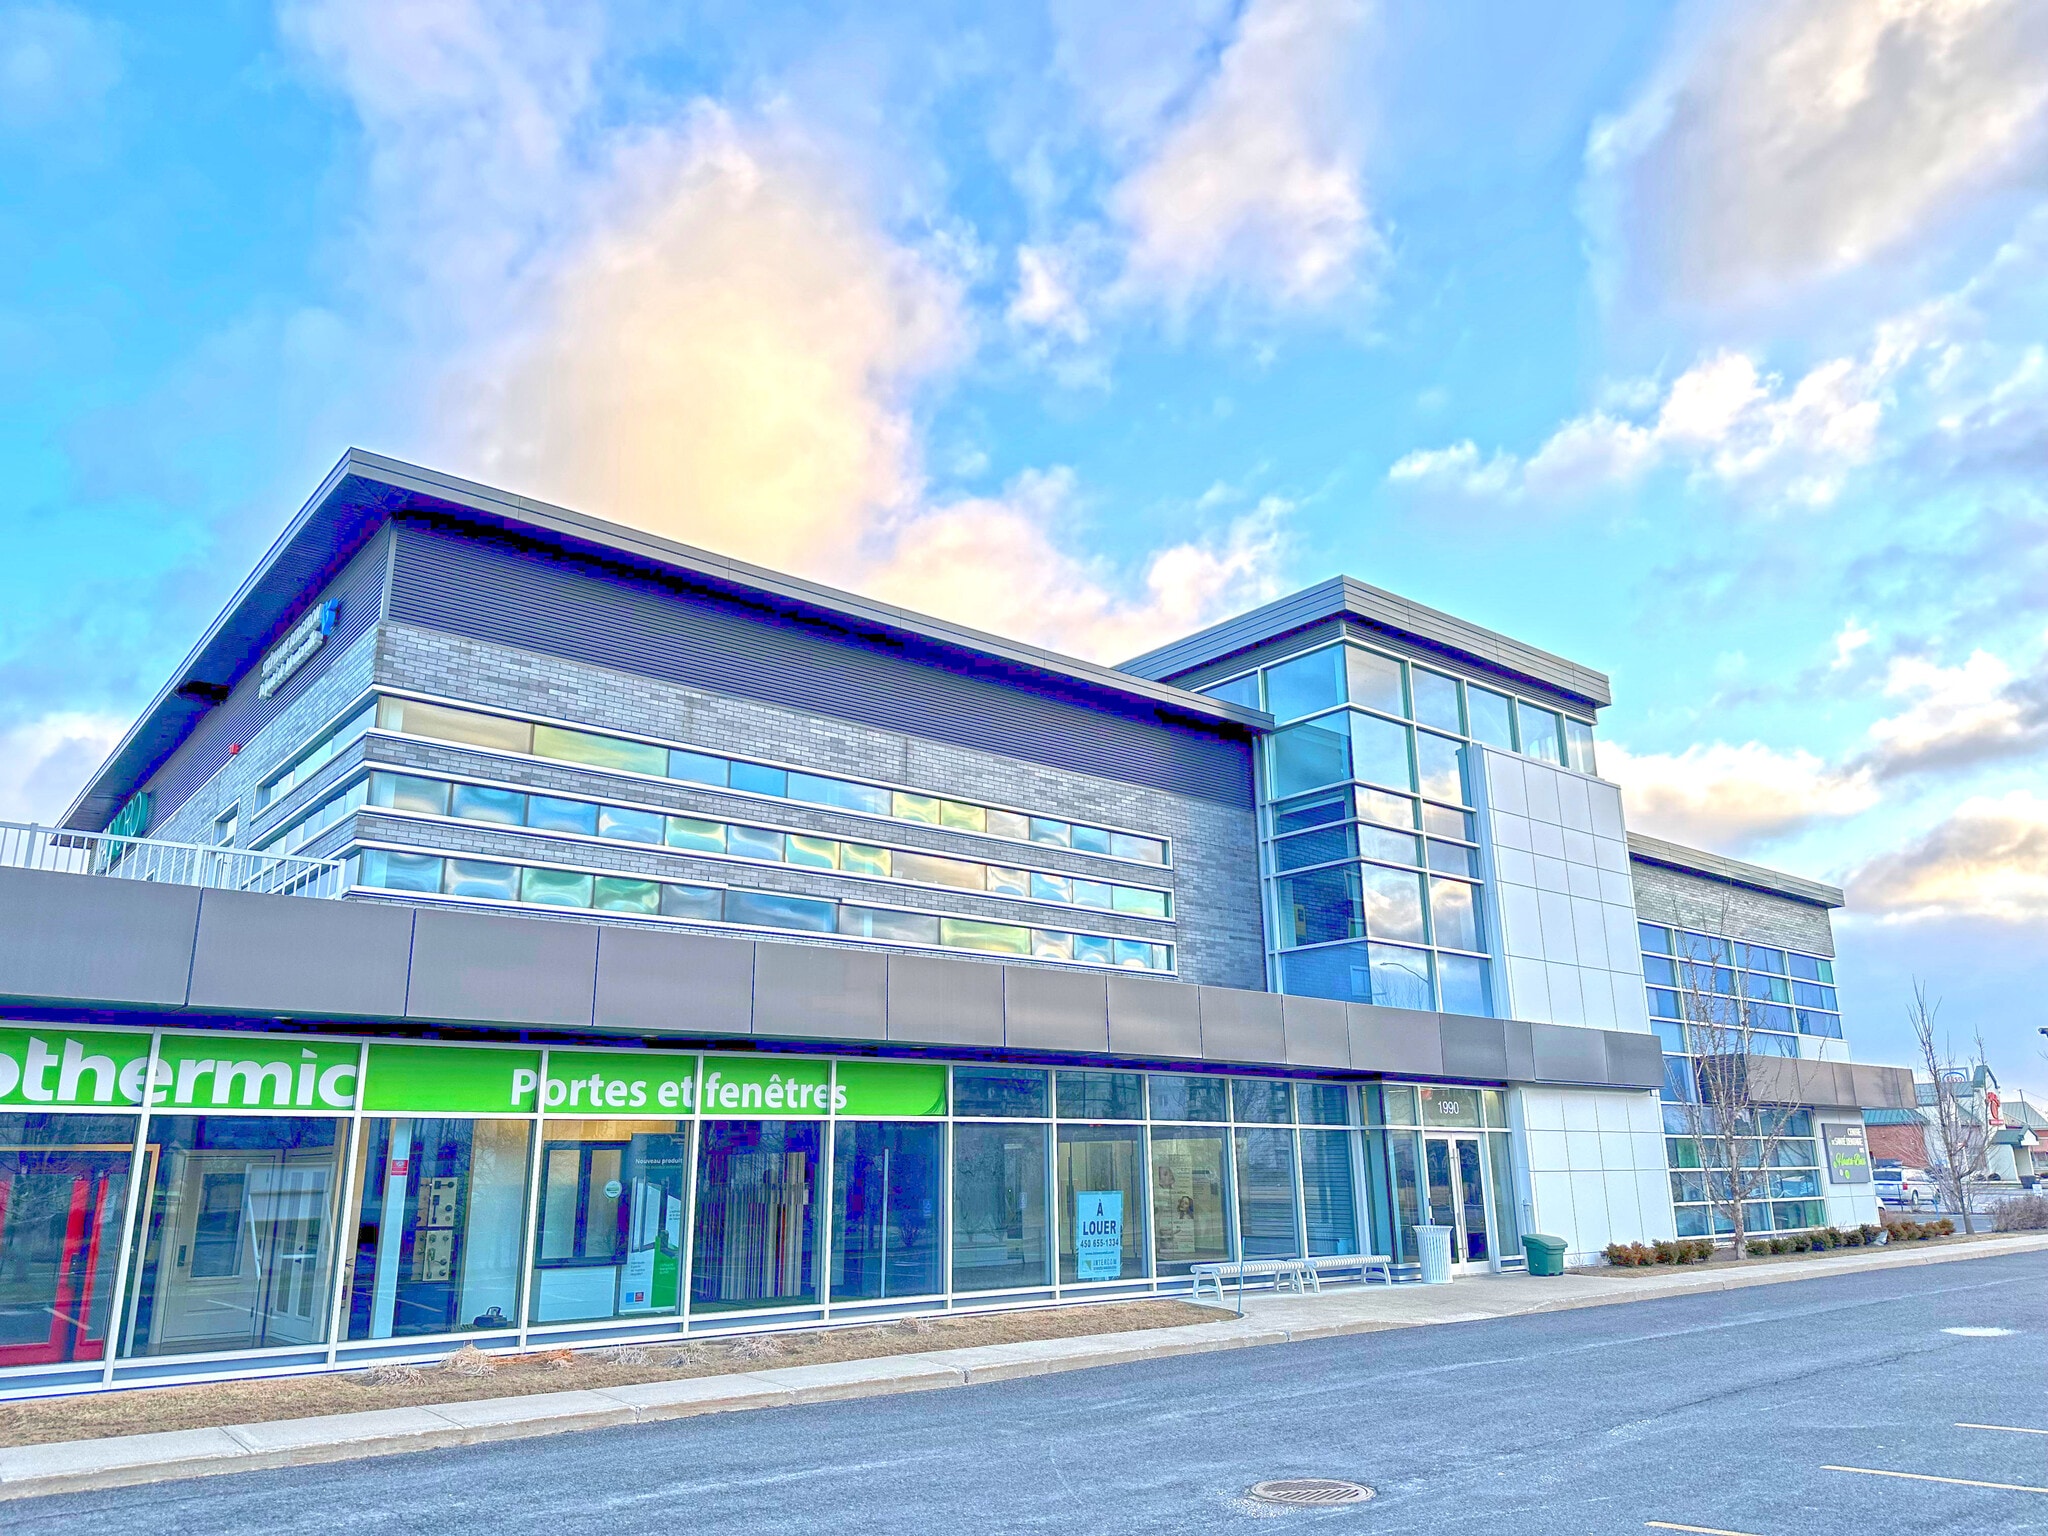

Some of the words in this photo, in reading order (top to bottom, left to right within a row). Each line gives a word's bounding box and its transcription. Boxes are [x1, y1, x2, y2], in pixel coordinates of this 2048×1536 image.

[510, 1068, 647, 1108] Portes
[657, 1075, 694, 1108] et
[705, 1071, 848, 1109] fenêtres
[1438, 1101, 1459, 1114] 1990
[661, 1157, 683, 1166] produit
[1096, 1198, 1104, 1217] À
[1082, 1220, 1117, 1236] LOUER
[1080, 1239, 1091, 1248] 450
[1092, 1238, 1119, 1247] 655-1334
